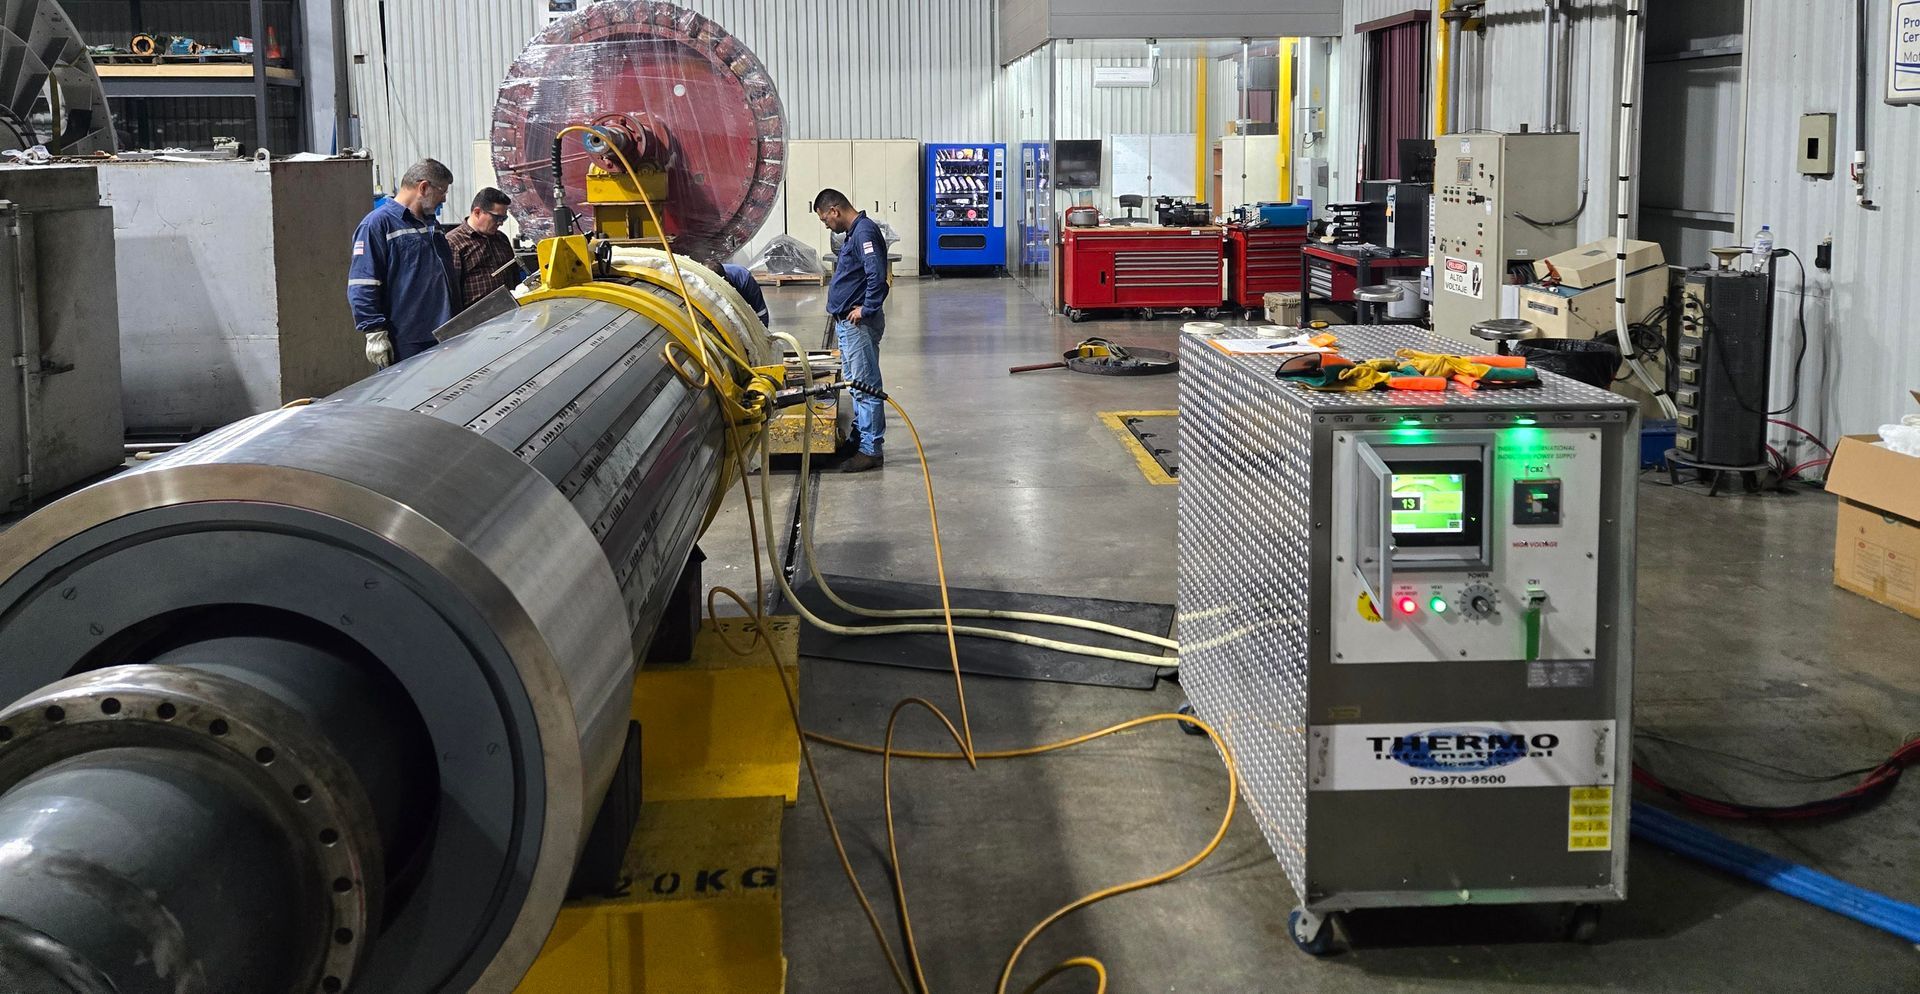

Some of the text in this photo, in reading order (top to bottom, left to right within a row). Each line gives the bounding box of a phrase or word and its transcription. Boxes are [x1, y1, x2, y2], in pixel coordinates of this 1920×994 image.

[1450, 273, 1463, 282] ALTO
[1445, 282, 1468, 294] VOLTAJE
[1401, 498, 1416, 509] 13
[1366, 733, 1560, 752] THERMO
[1375, 750, 1553, 760] International
[1409, 775, 1506, 785] 973-970-9500
